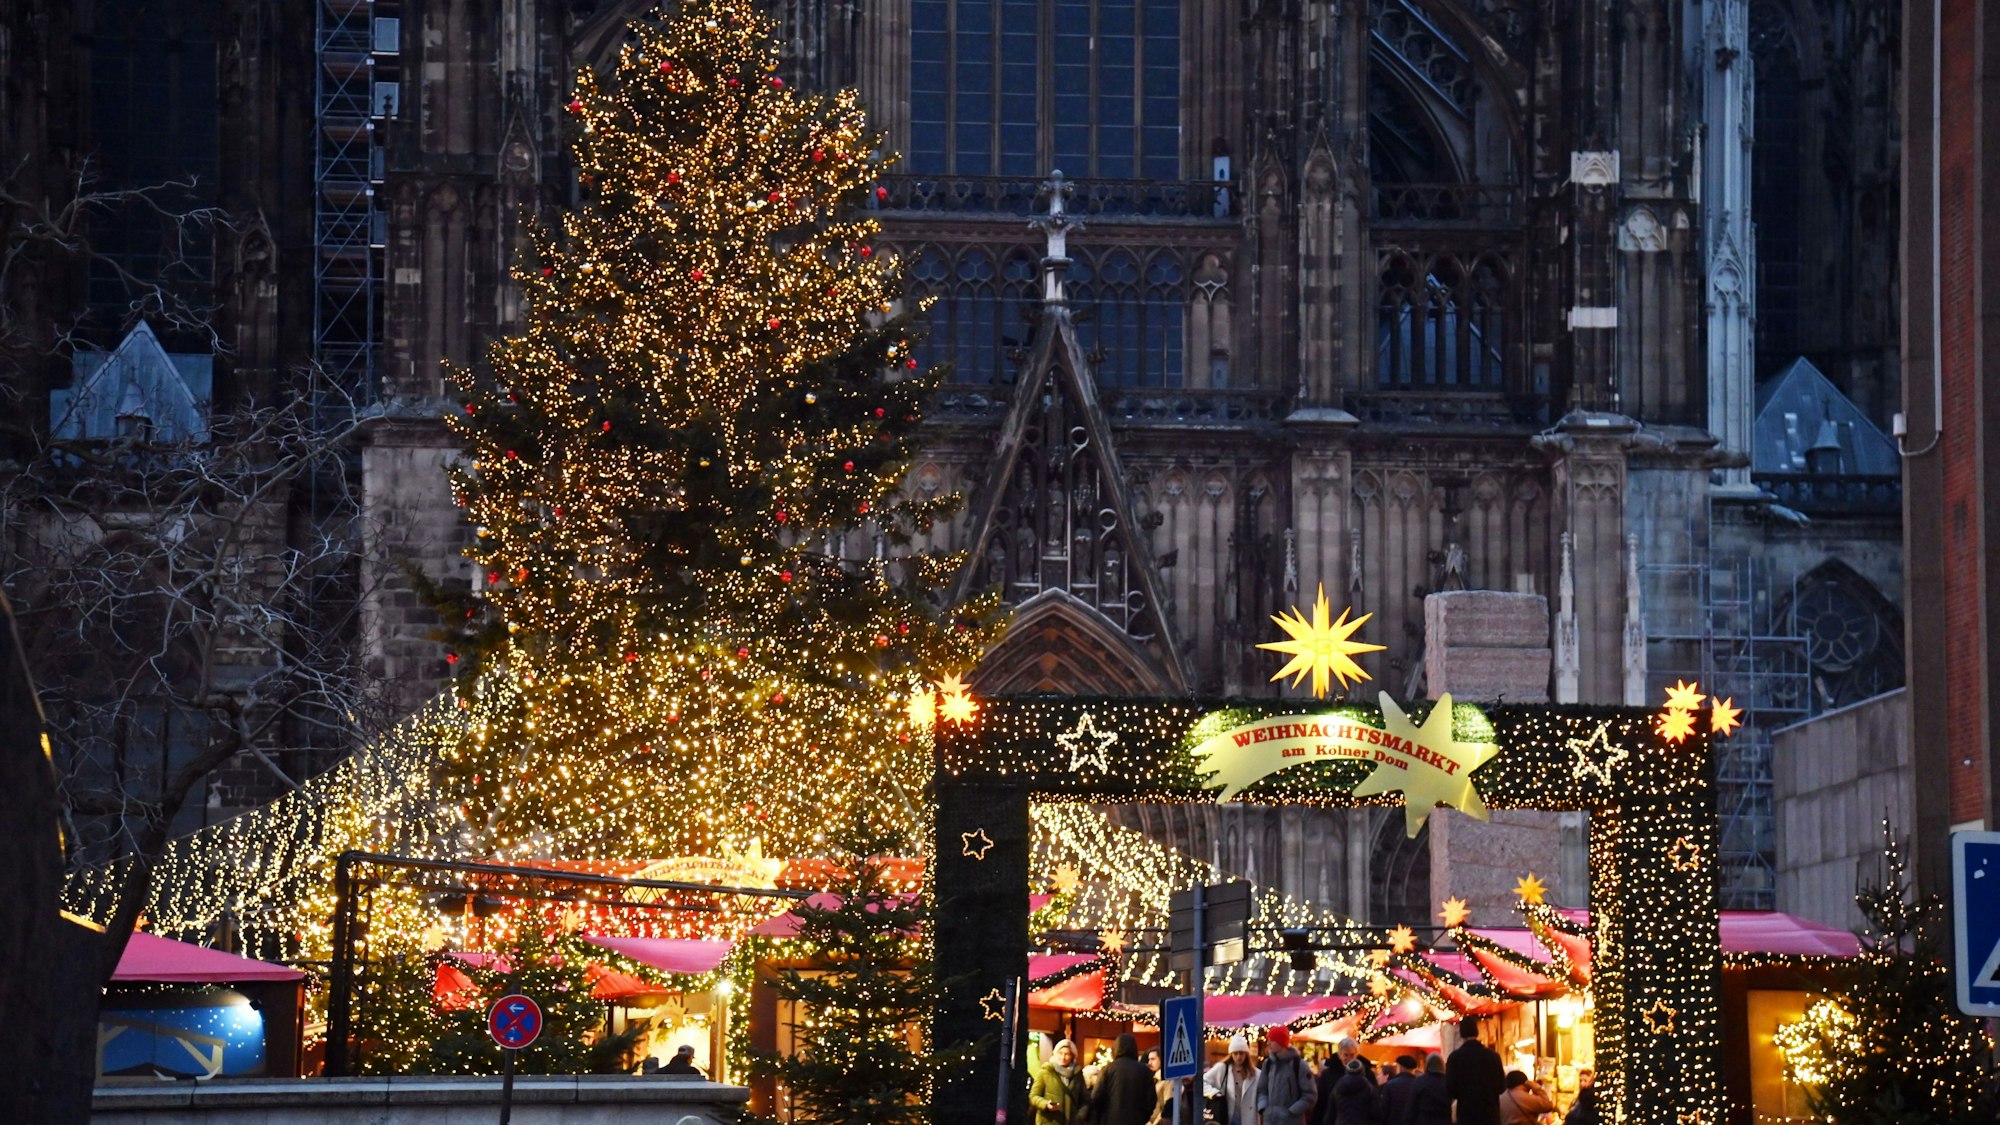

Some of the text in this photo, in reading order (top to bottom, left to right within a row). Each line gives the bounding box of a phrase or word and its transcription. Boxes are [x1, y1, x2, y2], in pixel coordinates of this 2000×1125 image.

[1232, 723, 1460, 776] WEIHNACHTSMARKT
[1282, 744, 1409, 770] am Kölner Dom
[643, 861, 766, 881] WEIHNACHTSMAKT
